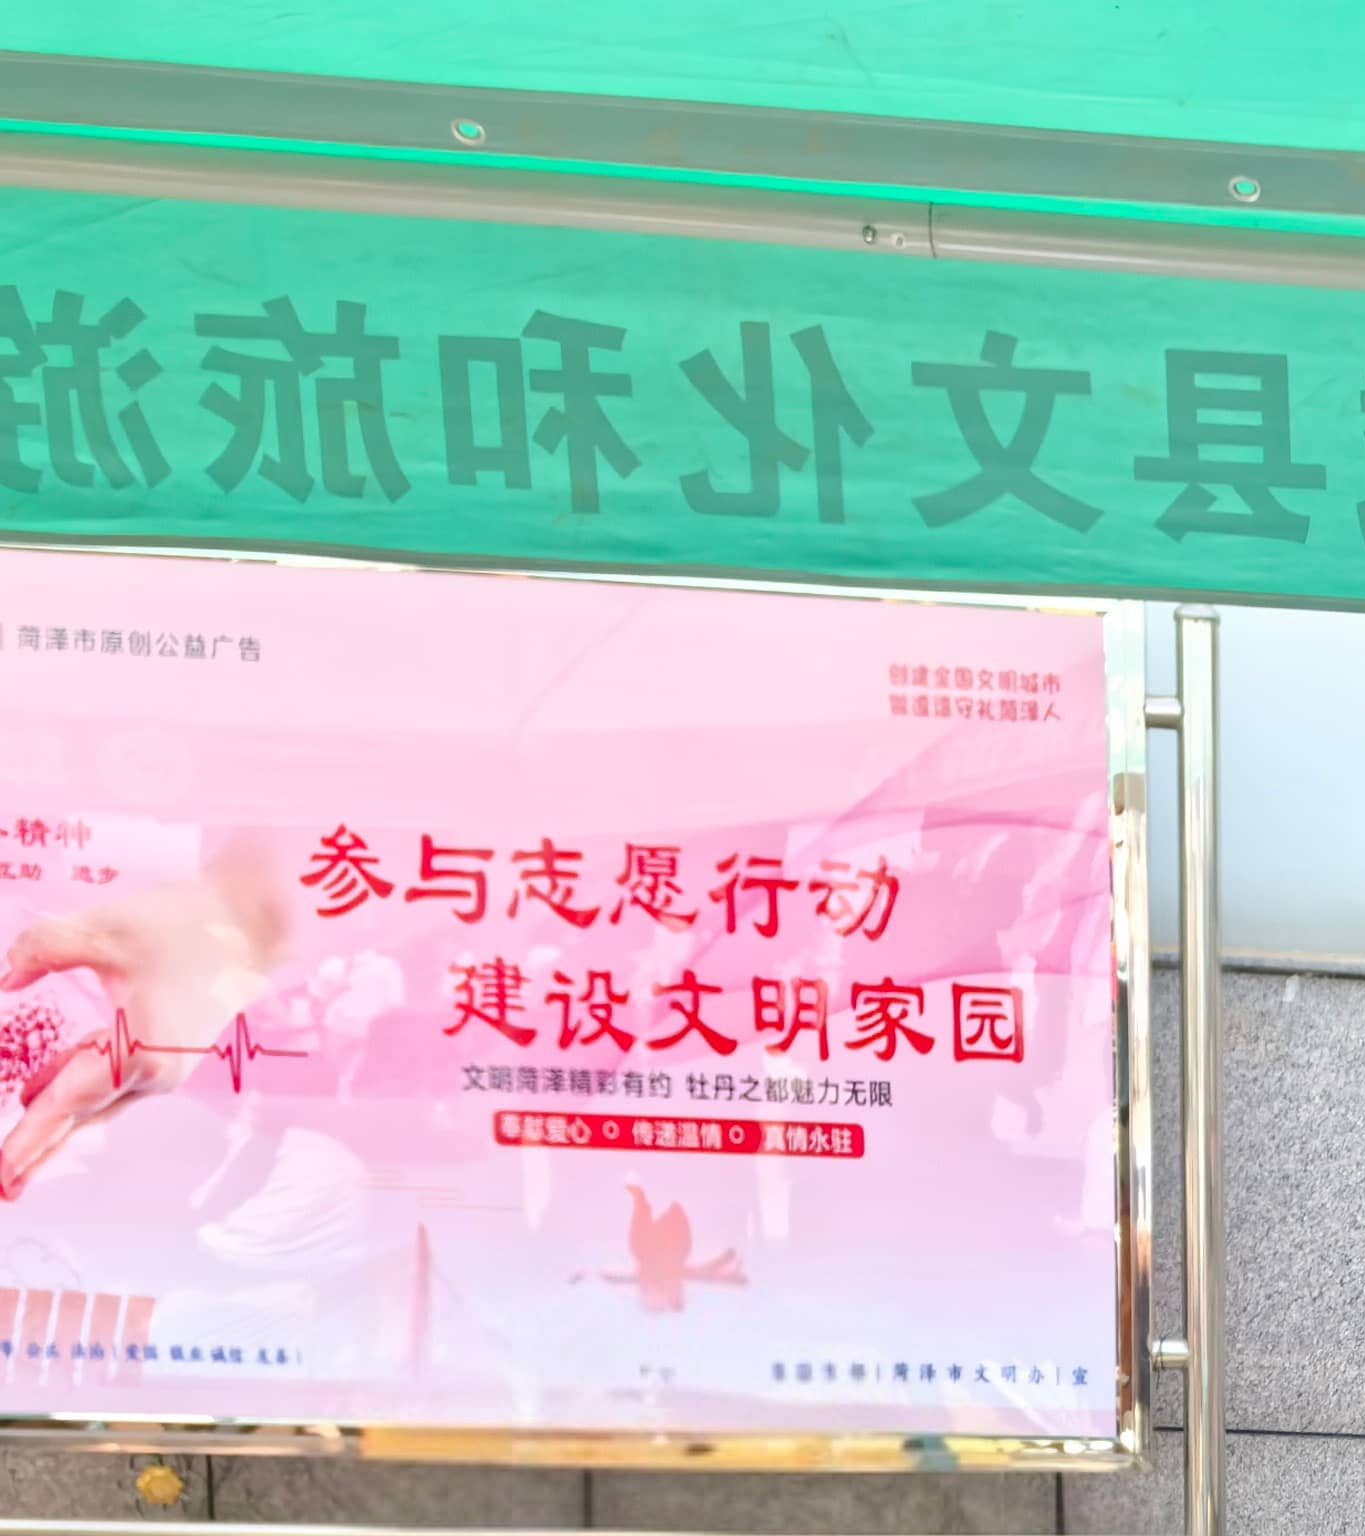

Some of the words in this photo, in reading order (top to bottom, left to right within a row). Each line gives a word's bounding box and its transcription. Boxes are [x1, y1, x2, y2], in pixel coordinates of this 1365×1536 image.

[17, 624, 262, 662] 菏泽市原创公益广告
[300, 822, 900, 941] 参与志愿行动
[443, 957, 1026, 1063] 建设文明家园
[462, 1064, 673, 1098] 文明菏泽精彩有约
[686, 1074, 894, 1108] 牡丹之都魅力无限
